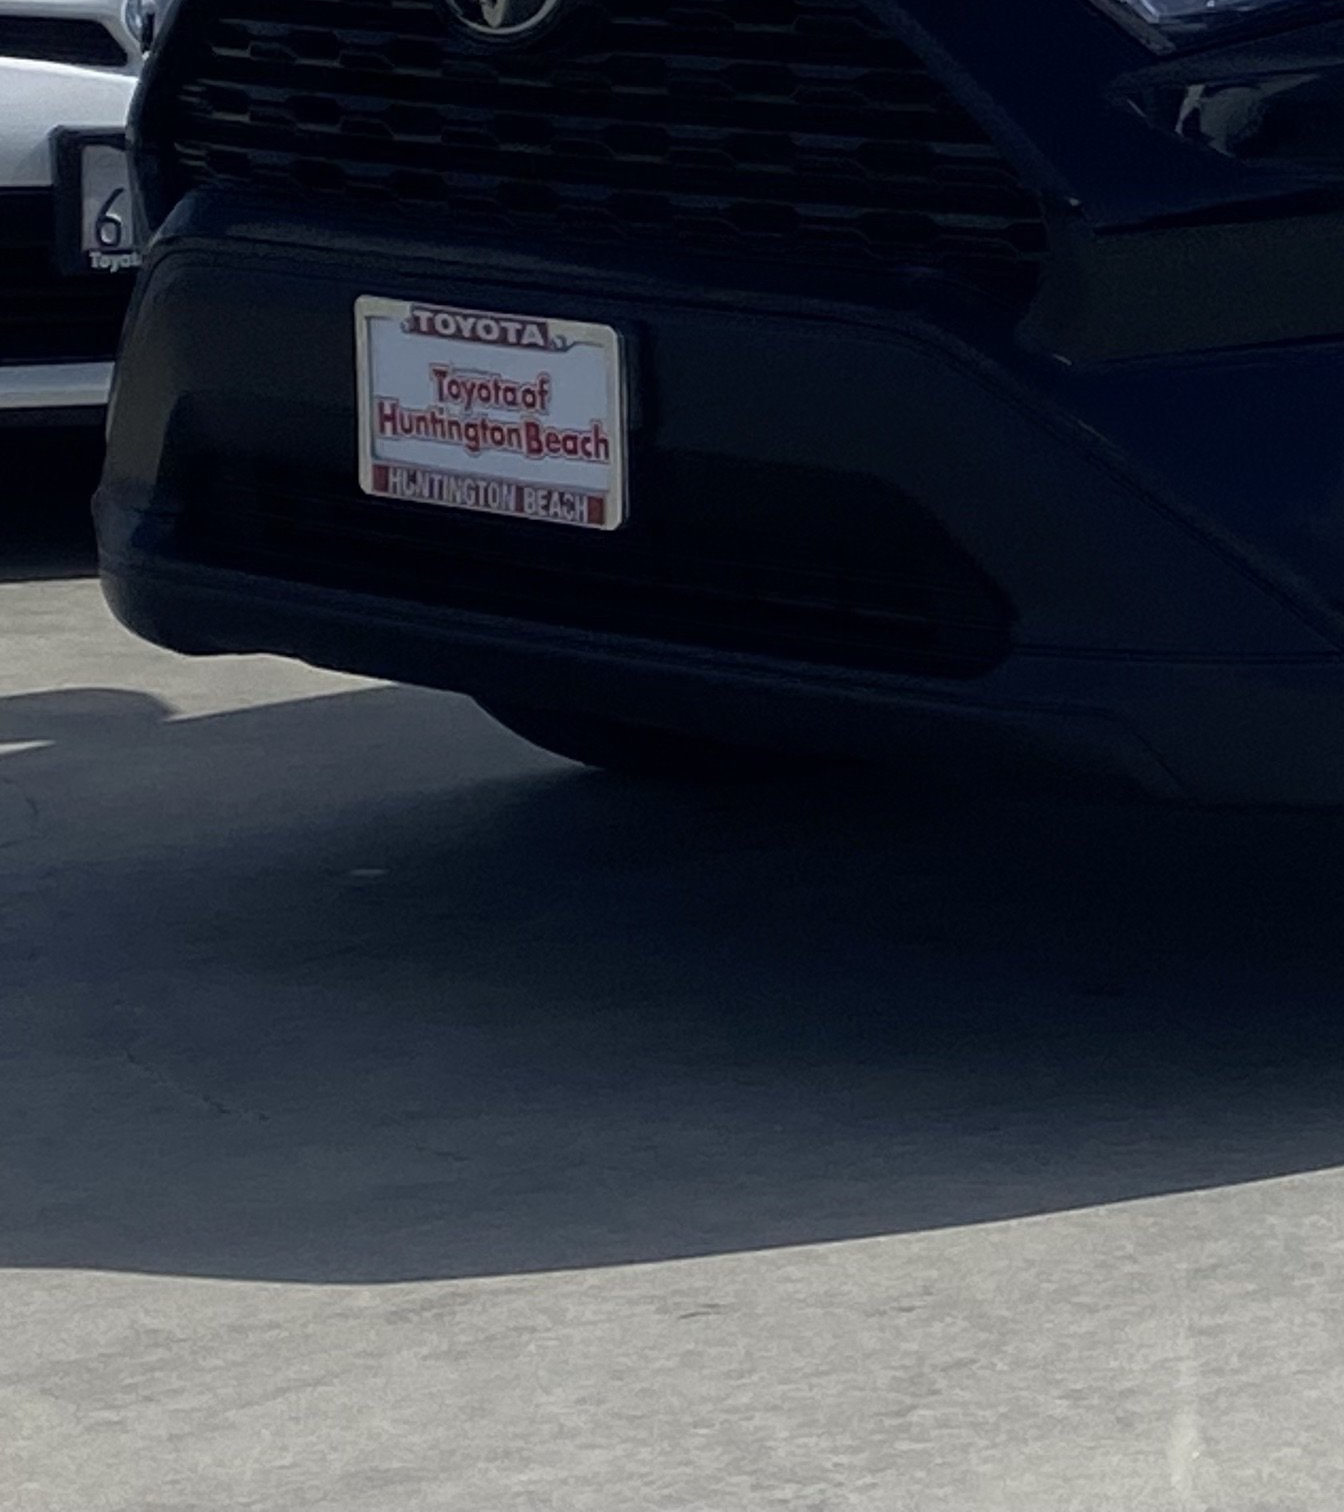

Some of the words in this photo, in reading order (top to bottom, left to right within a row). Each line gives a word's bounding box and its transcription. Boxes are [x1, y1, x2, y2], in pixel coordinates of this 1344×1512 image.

[95, 187, 124, 247] 6
[413, 310, 545, 346] TOYOTA
[432, 368, 517, 410] Toyota
[523, 375, 550, 410] of
[377, 401, 522, 452] Huntington
[524, 421, 610, 460] Beach
[388, 468, 517, 511] HUNTINGTON
[523, 488, 589, 522] BEACH
